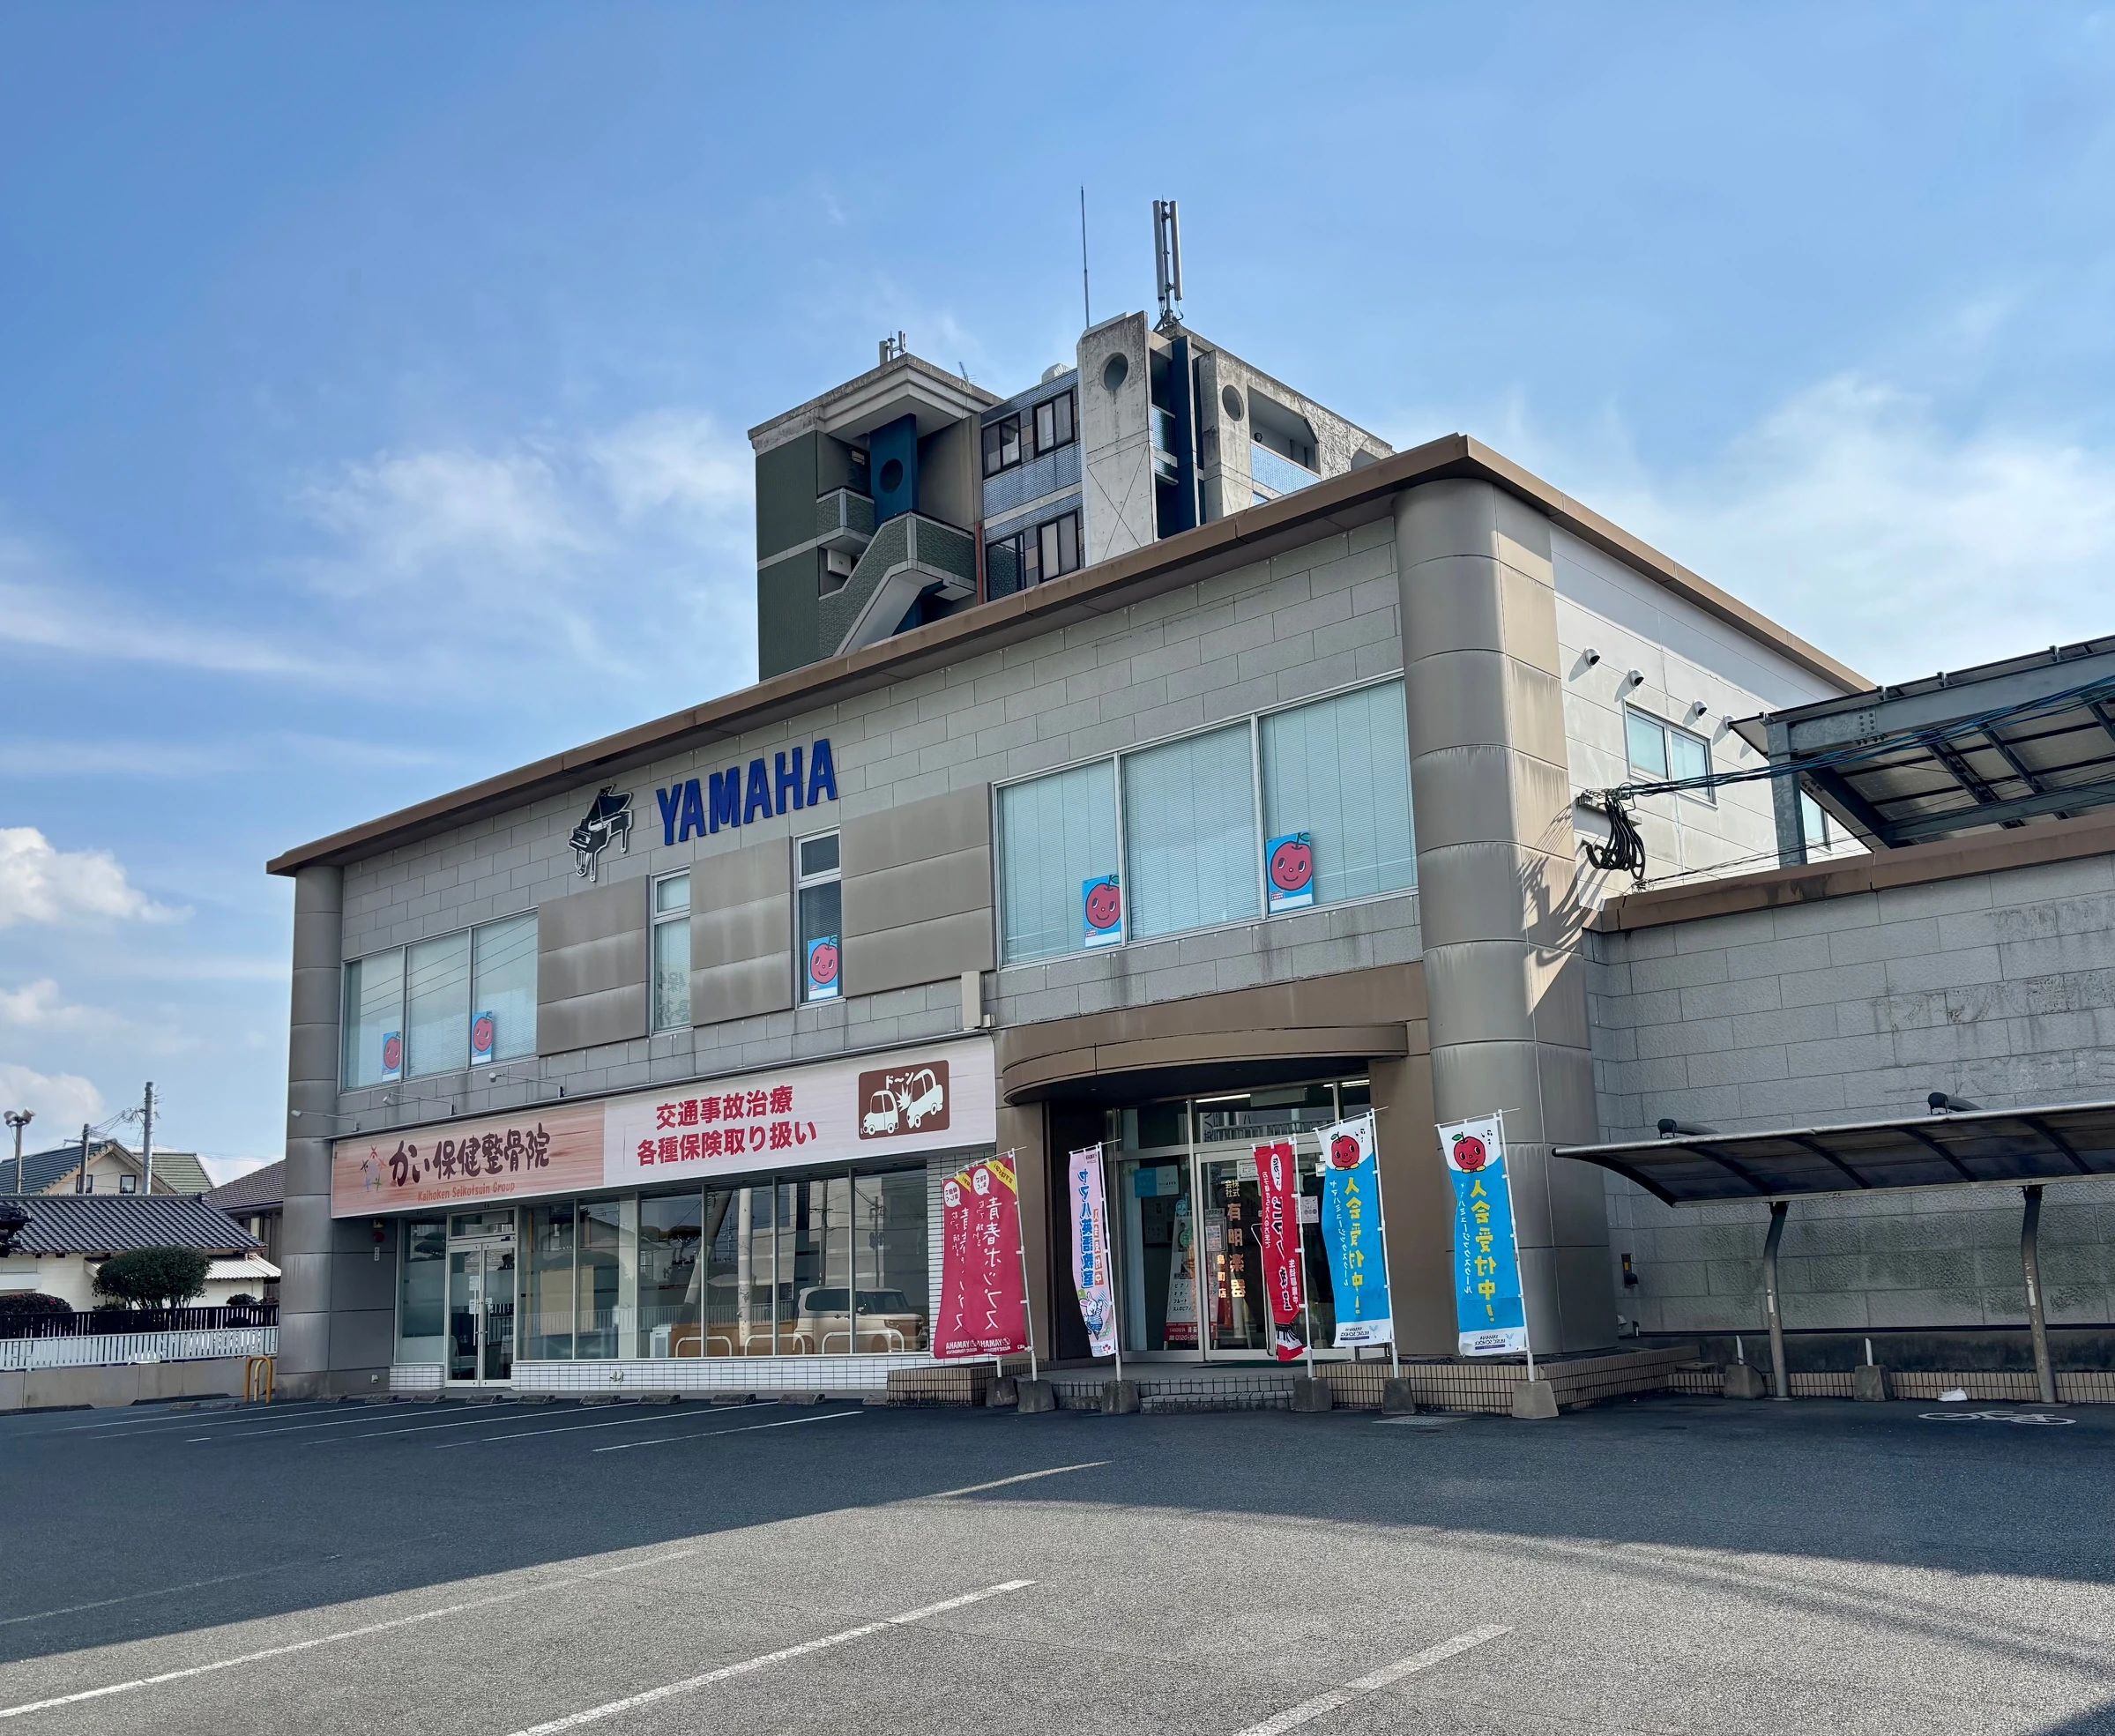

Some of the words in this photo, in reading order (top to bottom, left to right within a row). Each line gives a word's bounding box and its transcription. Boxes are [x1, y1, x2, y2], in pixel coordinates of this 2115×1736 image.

[656, 738, 838, 846] YAMAHA
[656, 1085, 793, 1131] 交通事故治療
[389, 1121, 550, 1187] かい保健整骨院
[637, 1120, 817, 1166] 各種保険取り扱い
[417, 1189, 451, 1202] Kaihoken
[451, 1185, 491, 1199] Seikotsuin
[492, 1181, 516, 1194] Group
[1227, 1203, 1246, 1298] 有明楽器
